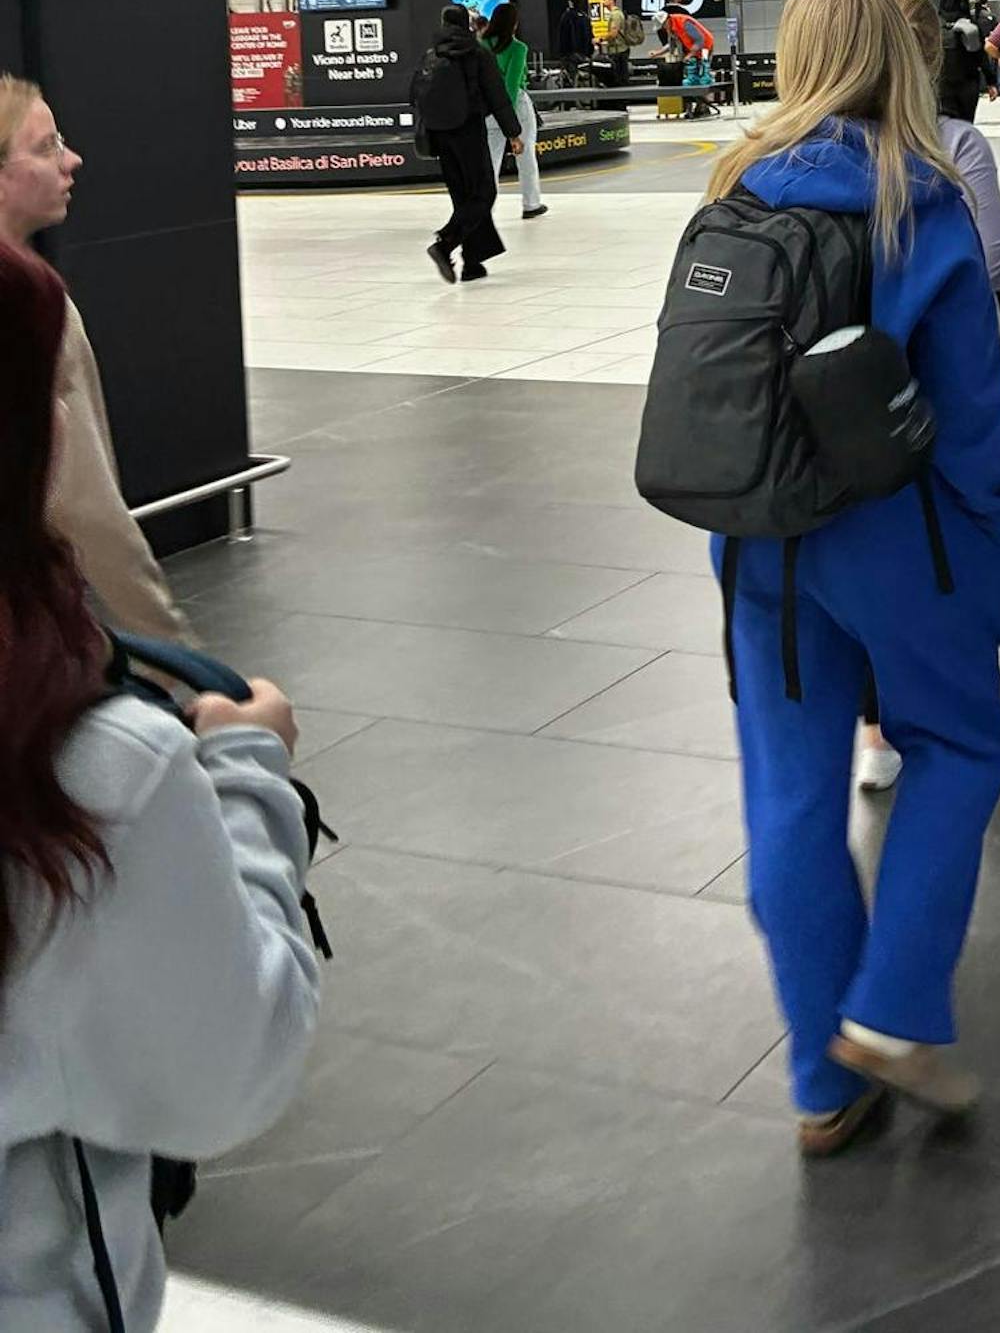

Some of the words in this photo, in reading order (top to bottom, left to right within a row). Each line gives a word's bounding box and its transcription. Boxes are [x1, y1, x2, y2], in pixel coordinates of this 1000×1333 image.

[312, 53, 345, 66] Vicino
[345, 53, 356, 65] al
[356, 53, 389, 64] nastro
[389, 50, 399, 64] 9
[328, 68, 353, 81] Near
[353, 67, 375, 80] belt
[375, 66, 384, 80] 9
[232, 118, 257, 131] Uber
[289, 116, 312, 129] Your
[312, 116, 331, 129] ride
[331, 116, 364, 128] around
[364, 114, 394, 127] Rome
[256, 157, 270, 171] at
[269, 155, 315, 171] Basilica
[315, 154, 329, 170] di
[329, 154, 357, 169] San
[358, 152, 405, 168] Pietro
